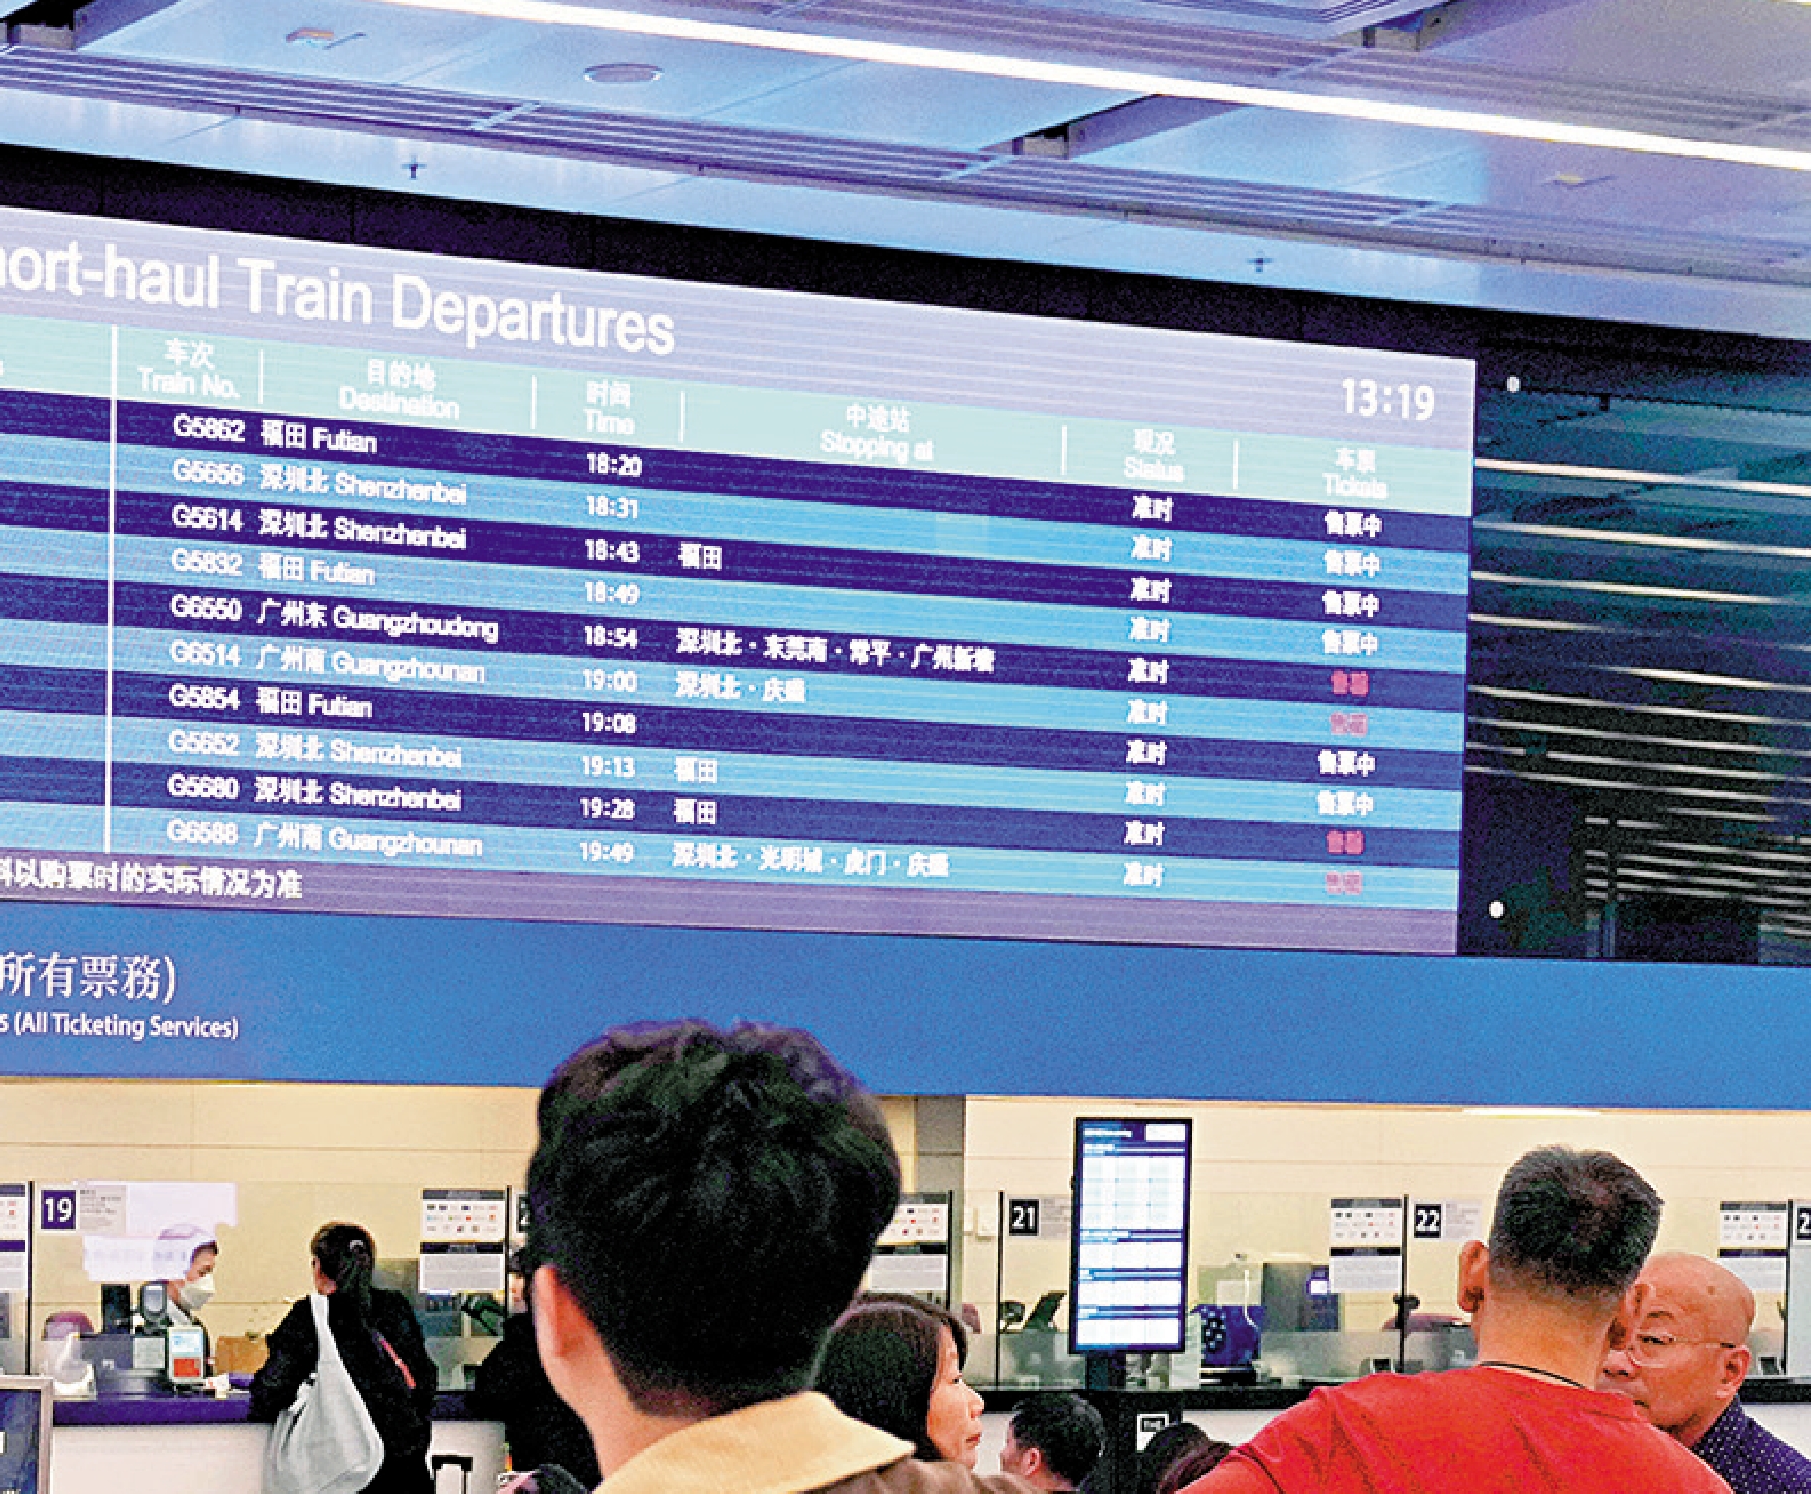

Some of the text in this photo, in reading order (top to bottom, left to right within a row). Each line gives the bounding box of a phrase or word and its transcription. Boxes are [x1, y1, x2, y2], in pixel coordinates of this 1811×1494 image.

[238, 258, 372, 324] Train
[393, 269, 681, 354] Departures
[1343, 379, 1434, 420] 13:19
[587, 452, 642, 477] 18:20
[587, 496, 637, 518] 18:31
[585, 539, 640, 562] 18:43
[585, 581, 640, 605] 18:49
[585, 626, 637, 649] 18:54
[583, 669, 637, 692] 19:00
[583, 713, 635, 733] 19:08
[583, 756, 635, 777] 19:13
[580, 797, 635, 820] 19:28
[580, 840, 633, 863] 19:49
[14, 1009, 48, 1036] (All
[52, 1011, 144, 1041] Ticketing
[149, 1014, 239, 1040] Services)
[45, 1197, 73, 1221] 19
[1012, 1206, 1035, 1227] 21
[1415, 1209, 1439, 1231] 22
